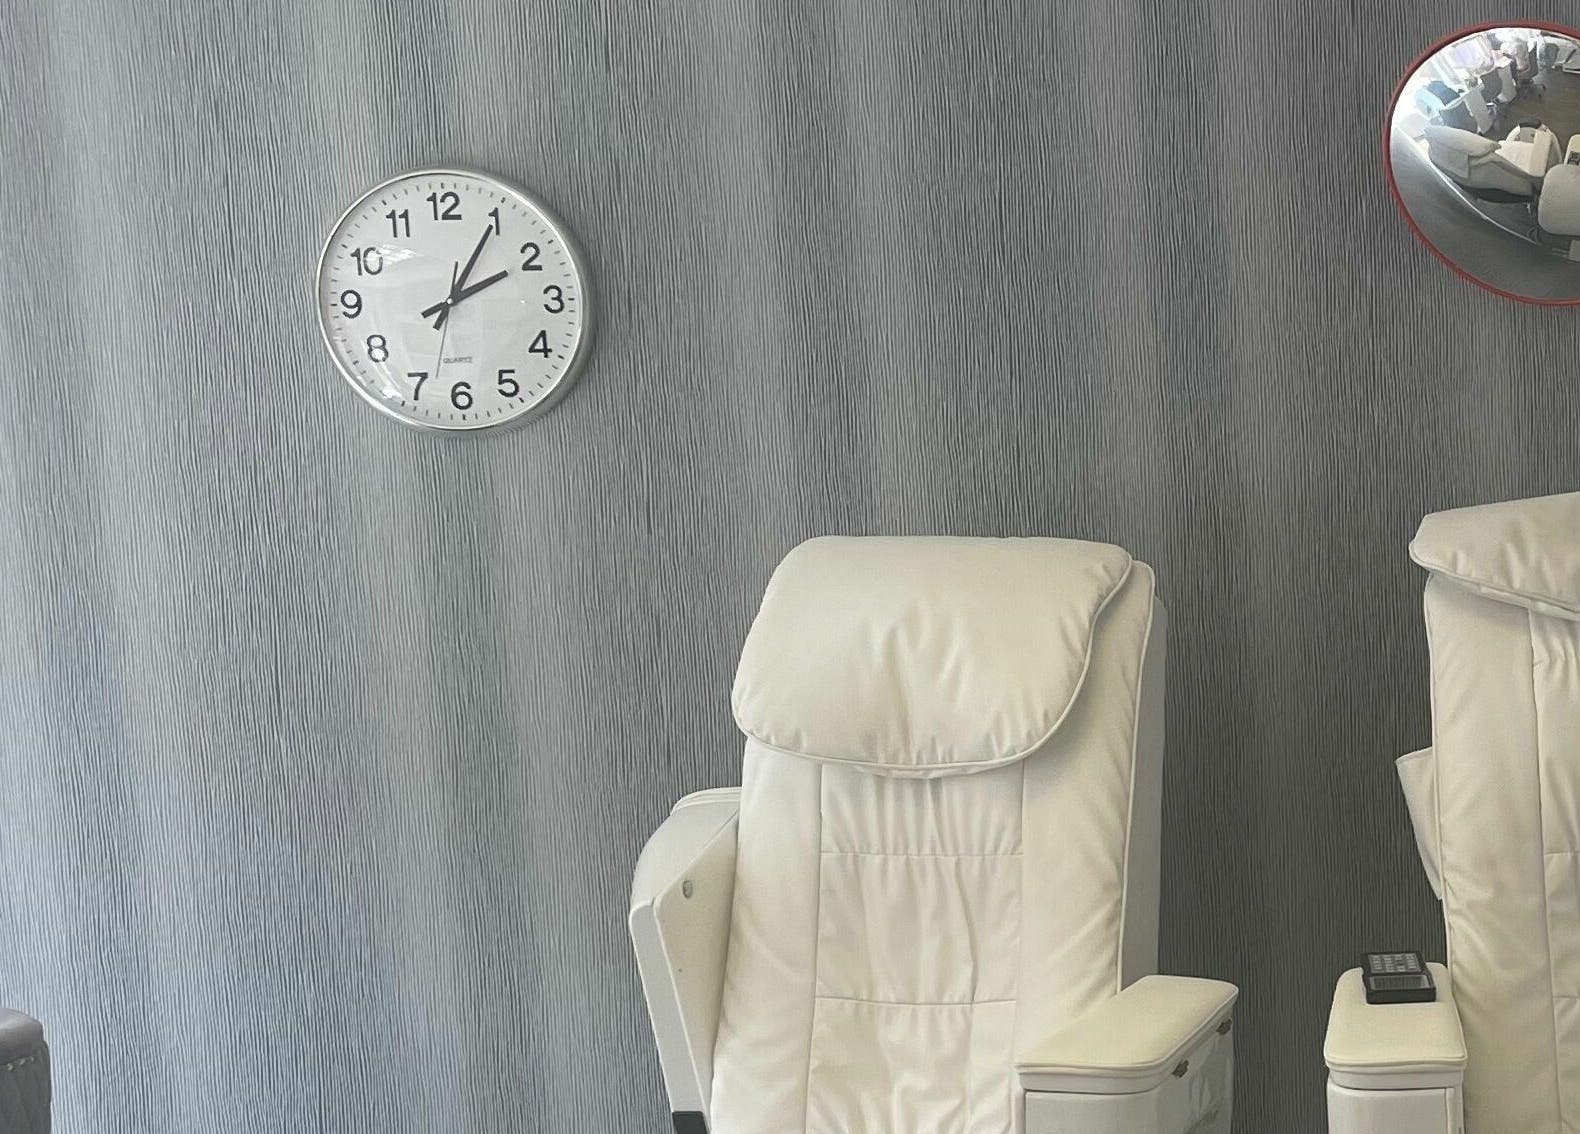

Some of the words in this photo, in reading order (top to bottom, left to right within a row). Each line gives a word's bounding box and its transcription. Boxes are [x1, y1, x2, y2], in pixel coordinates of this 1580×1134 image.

[427, 191, 462, 220] 12
[386, 208, 411, 238] 11
[488, 207, 500, 236] 1
[351, 247, 383, 276] 10
[520, 242, 543, 271] 2
[340, 289, 362, 318] 9
[543, 285, 565, 314] 3
[366, 334, 388, 363] 8
[528, 330, 553, 358] 4
[407, 372, 429, 401] 7
[451, 381, 473, 410] 6
[498, 369, 520, 398] 5
